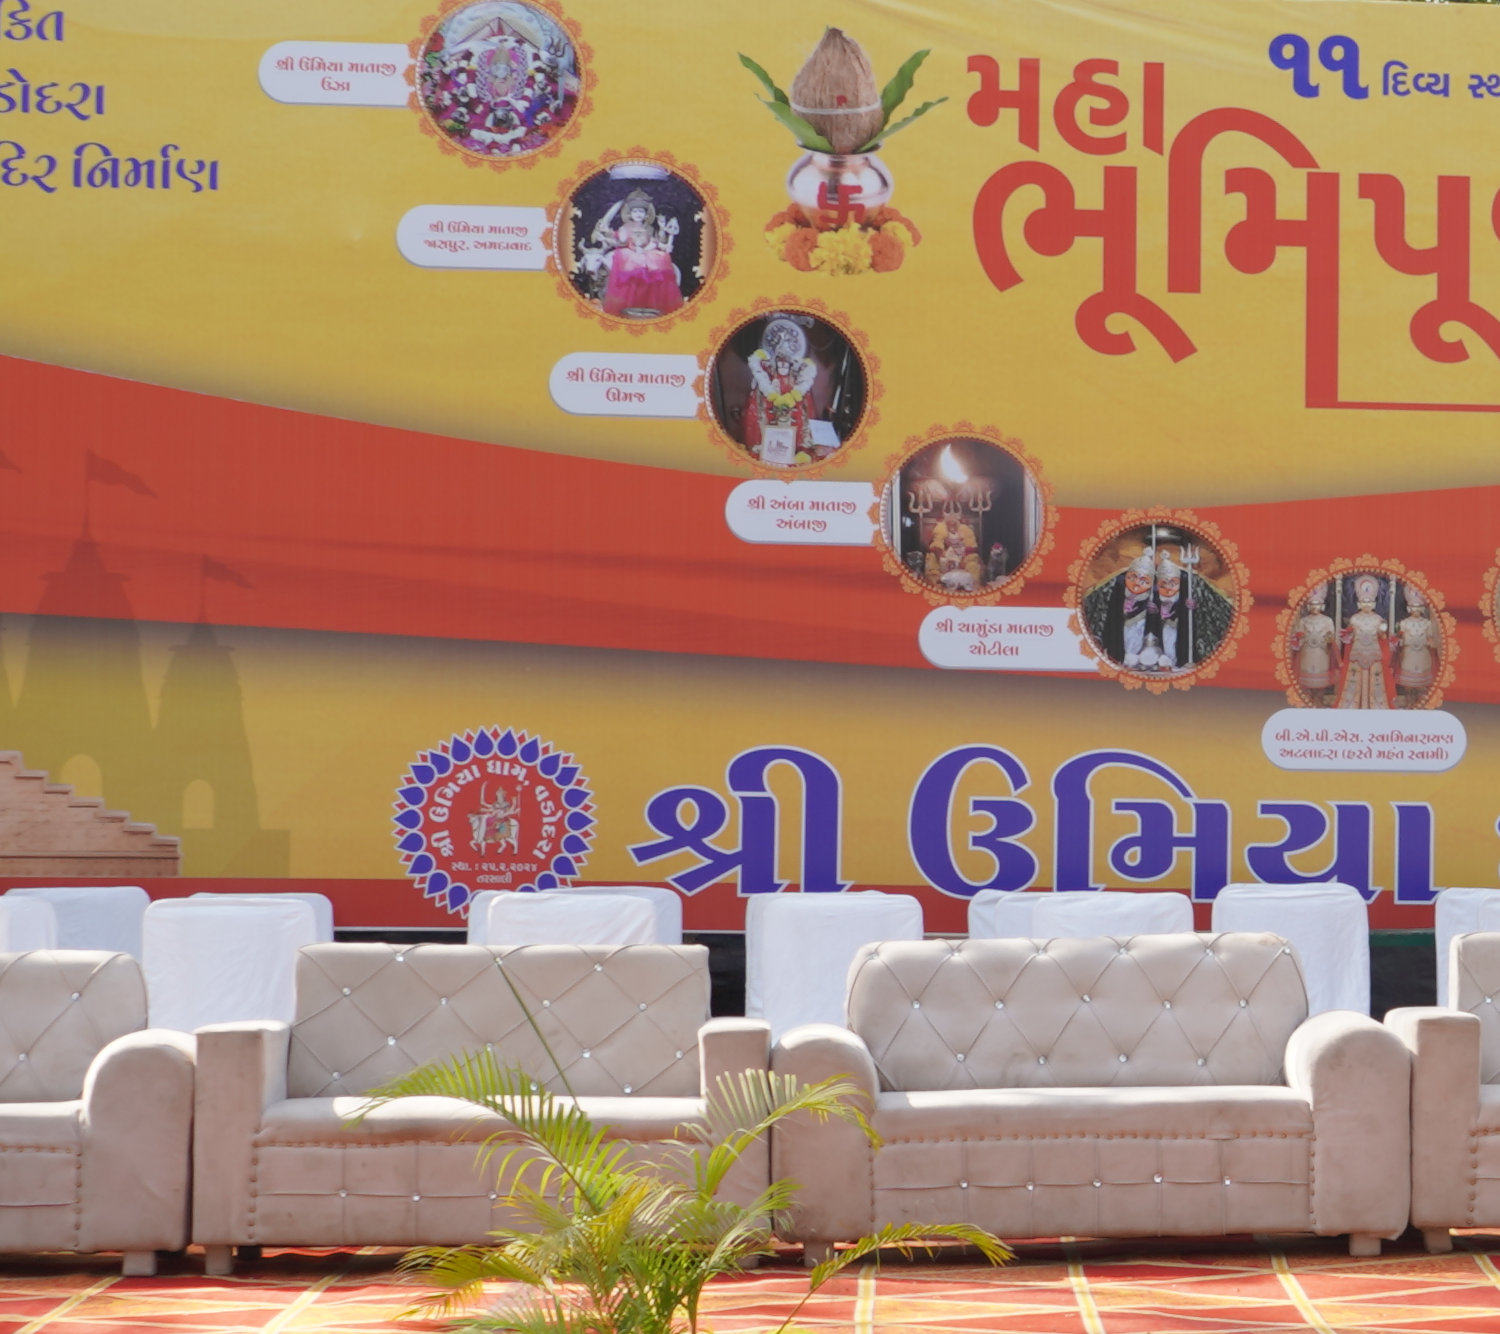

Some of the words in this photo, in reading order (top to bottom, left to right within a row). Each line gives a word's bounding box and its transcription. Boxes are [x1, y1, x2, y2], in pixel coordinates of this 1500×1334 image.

[275, 56, 294, 72] શ્રી
[348, 62, 397, 77] માતાજી
[1268, 33, 1369, 100] ૧૧
[1382, 60, 1450, 98] દિવ્ય
[965, 53, 1165, 157] મહા
[73, 142, 220, 194] નિર્માણ
[428, 220, 444, 234] શ્રી
[565, 367, 585, 382] શ્રી
[637, 373, 686, 388] માતાજી
[747, 495, 766, 510] શ્રી
[770, 496, 805, 511] અંબા
[808, 500, 857, 515] માતાજી
[775, 515, 828, 533] અંબાજી
[935, 618, 953, 634] શ્રી
[1007, 623, 1054, 638] માતાજી
[968, 640, 1020, 656] ચોટીલા
[629, 744, 854, 898] શ્રી
[906, 744, 1451, 906] ઉમિયા
